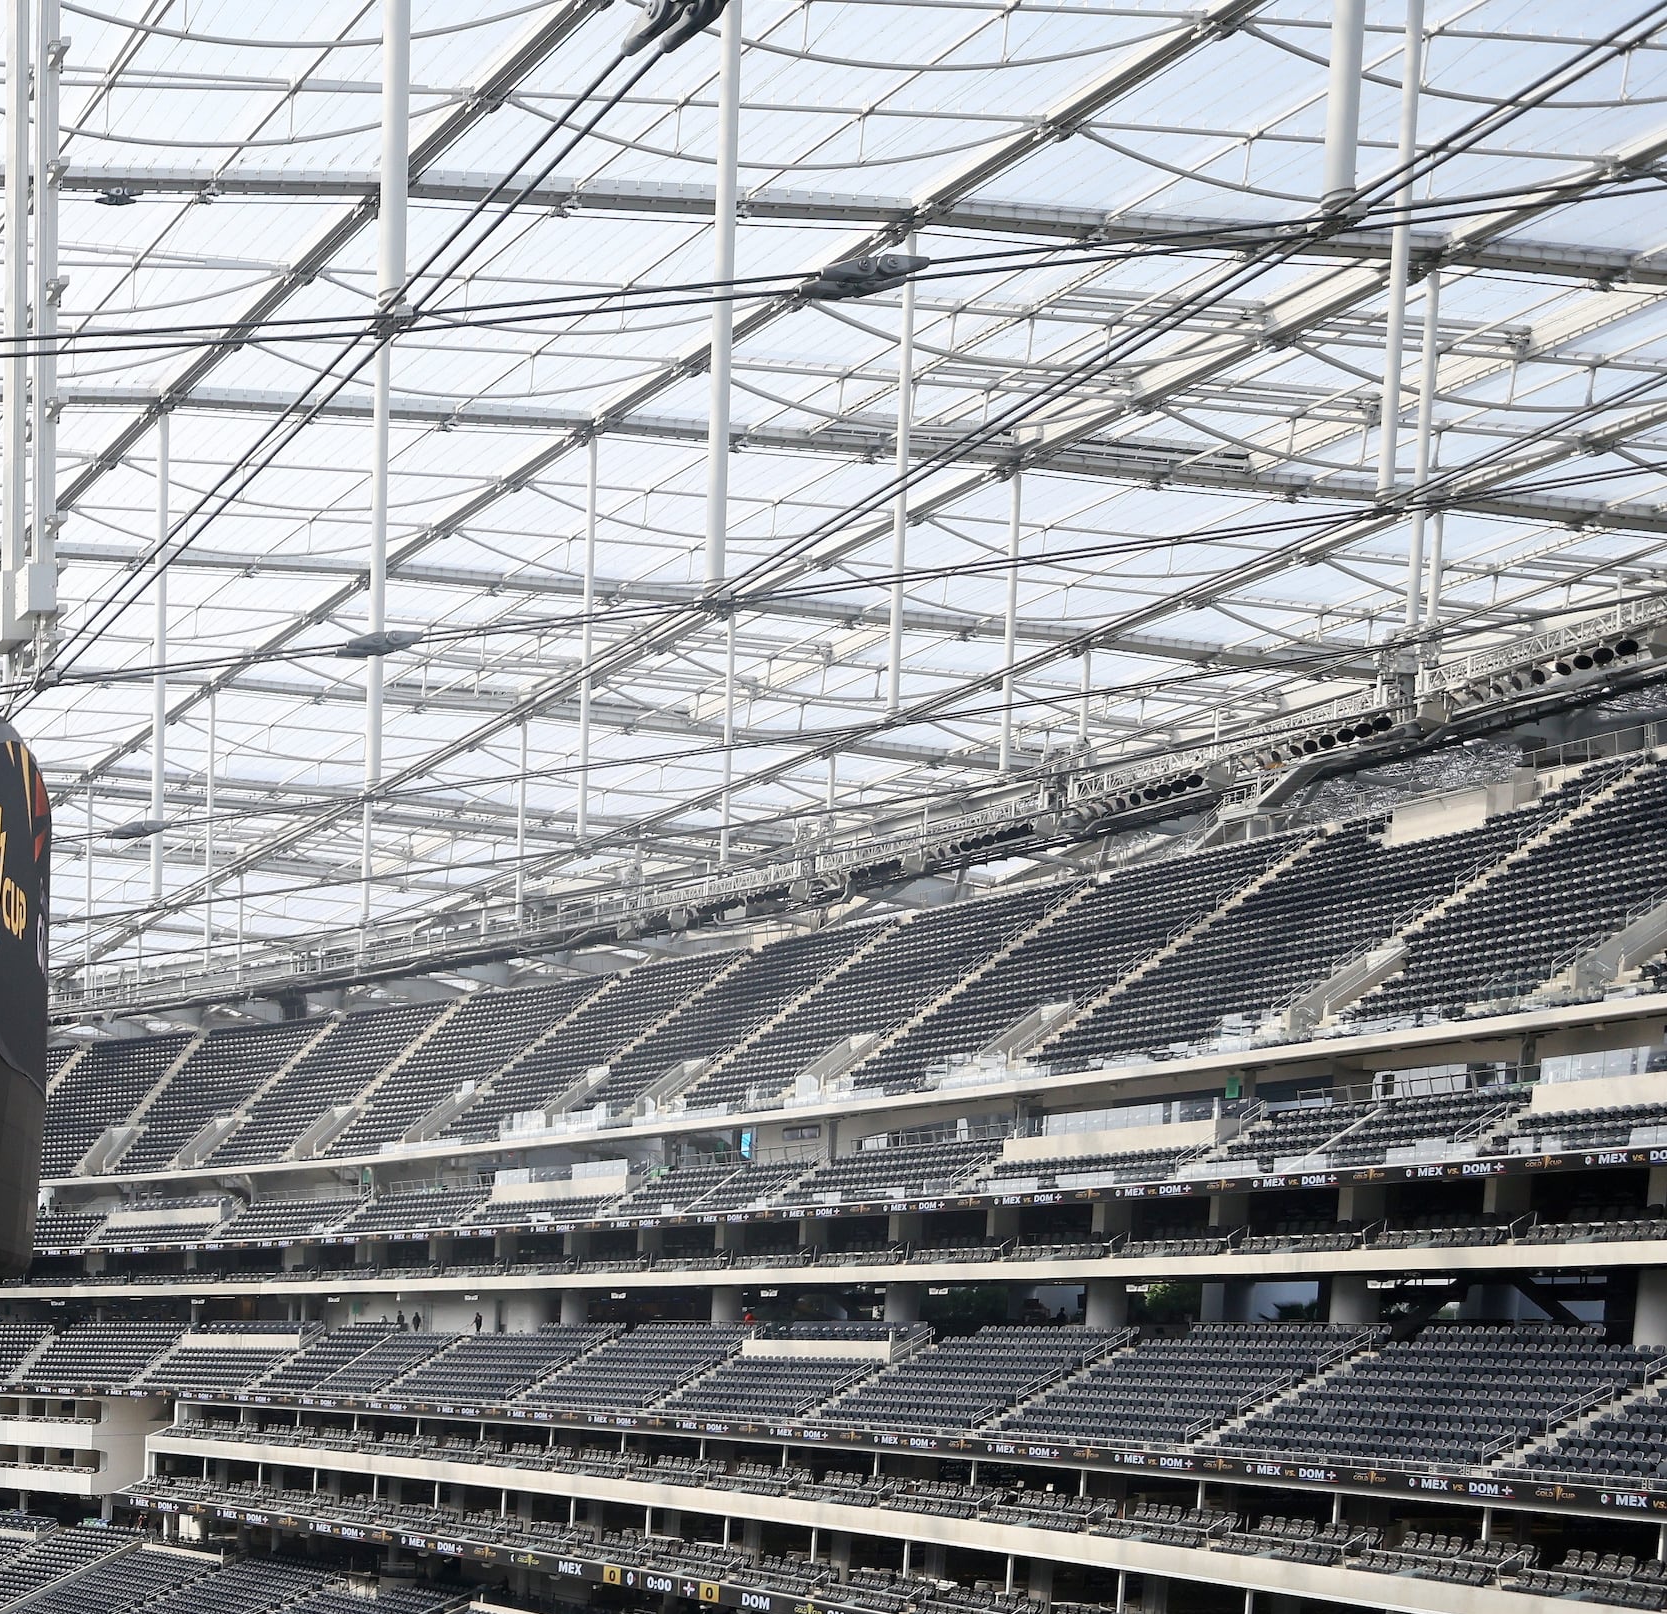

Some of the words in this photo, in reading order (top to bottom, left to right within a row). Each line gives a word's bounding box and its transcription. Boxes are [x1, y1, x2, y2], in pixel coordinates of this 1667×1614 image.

[2, 876, 27, 940] CUP
[1598, 1151, 1628, 1165] MEX
[1417, 1164, 1443, 1176] MEX
[1462, 1163, 1492, 1175] DOM
[1263, 1175, 1286, 1187] MEX
[1301, 1174, 1326, 1186] DOM
[1256, 1463, 1281, 1477] MEX
[1298, 1468, 1325, 1480] DOM
[1421, 1477, 1449, 1492] MEX
[1468, 1481, 1499, 1496] DOM
[1615, 1493, 1648, 1509] MEX
[408, 1535, 426, 1549] MEX
[436, 1540, 456, 1553] DOM
[558, 1559, 582, 1576] MEX
[646, 1574, 673, 1592] 0:00
[741, 1592, 771, 1611] DOM
